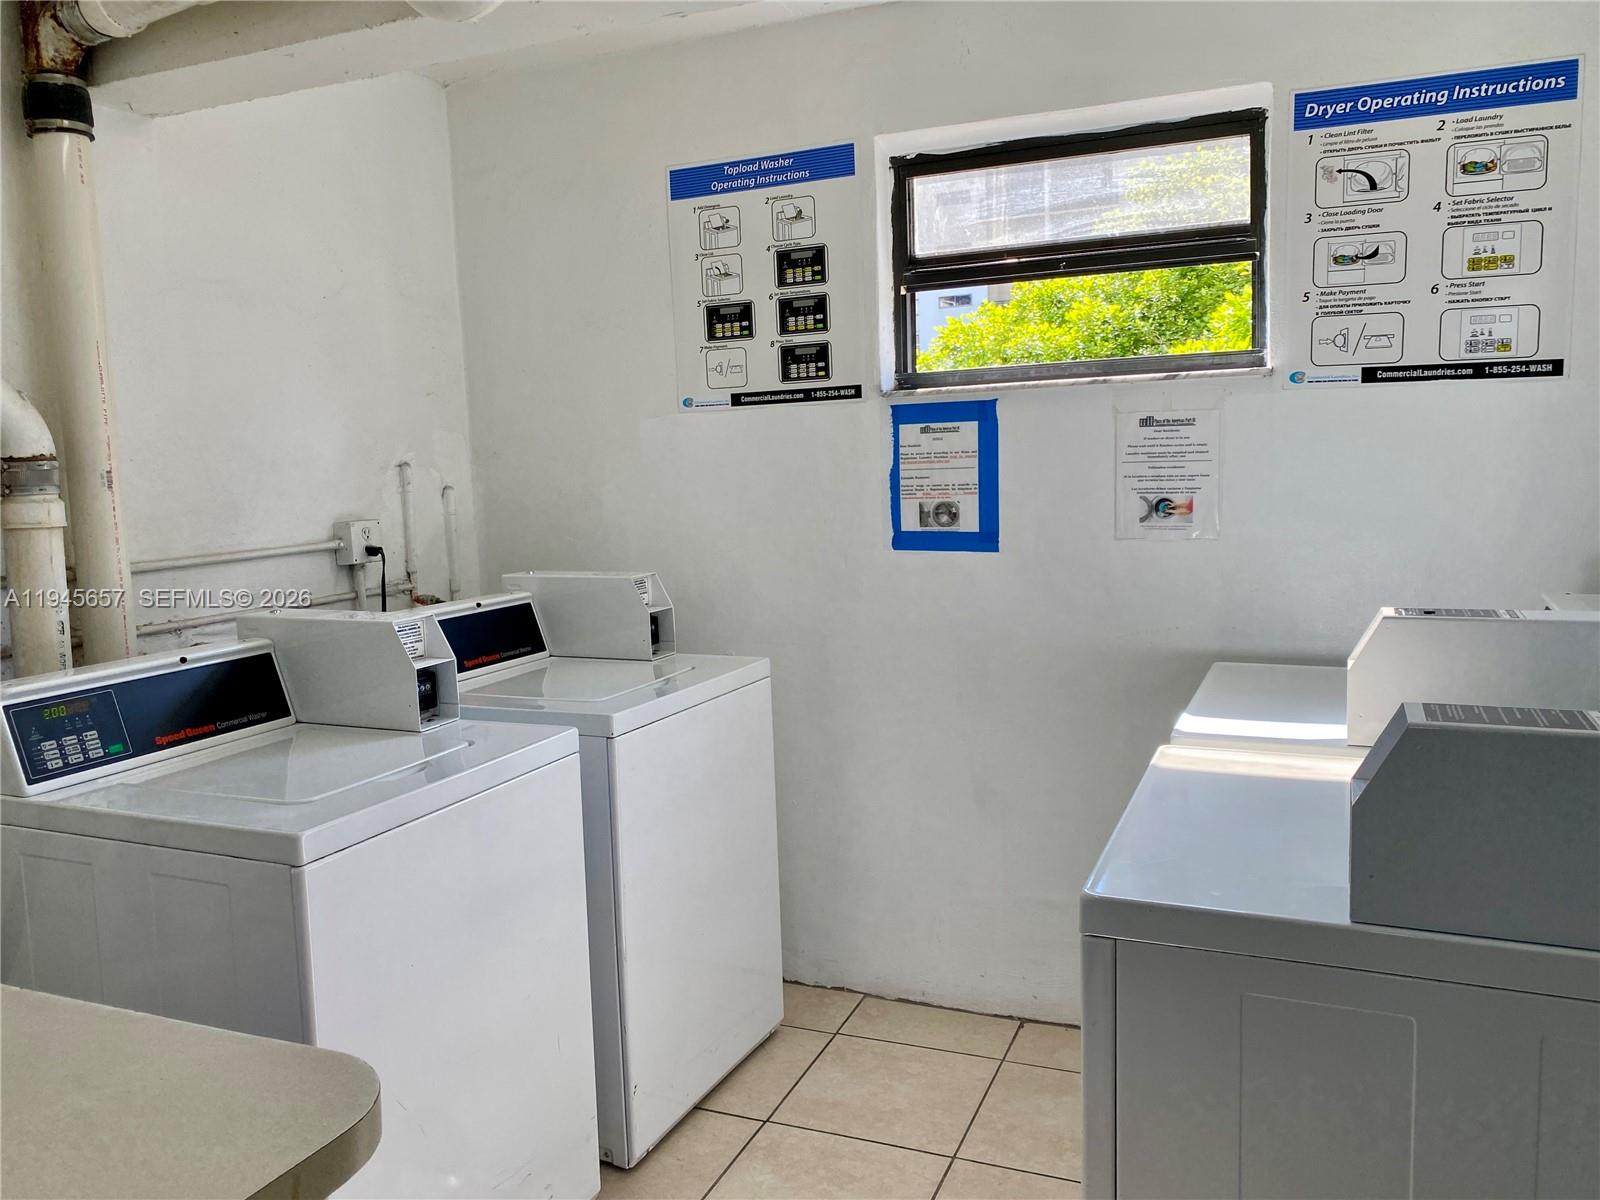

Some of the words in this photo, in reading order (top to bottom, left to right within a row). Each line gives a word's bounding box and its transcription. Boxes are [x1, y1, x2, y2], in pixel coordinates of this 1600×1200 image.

[1304, 102, 1354, 119] Dryer
[1357, 89, 1449, 113] Operating
[1453, 74, 1566, 100] Instructions
[1456, 116, 1474, 124] Load
[1474, 114, 1504, 122] Laundry
[1436, 120, 1446, 132] 2
[1308, 135, 1314, 145] 1
[723, 161, 758, 176] Topload
[760, 158, 794, 170] Washer
[711, 177, 755, 192] Operating
[757, 170, 810, 185] Instructions
[1464, 197, 1484, 205] Fabric
[1433, 201, 1442, 212] 4
[1304, 213, 1312, 223] 3
[1340, 209, 1366, 217] Loading
[766, 245, 771, 253] 4
[1338, 289, 1366, 297] Payment
[1431, 283, 1440, 295] 6
[768, 293, 774, 301] 6
[1302, 292, 1310, 302] 5
[697, 300, 701, 308] 5
[770, 340, 775, 348] 8
[700, 346, 704, 354] 7
[1377, 367, 1473, 378] CommercialLaundries.com
[1485, 363, 1553, 374] 1-855-254-WASH
[741, 392, 804, 403] CommercialLaundries.com
[811, 388, 855, 399] 1-855-254-WASH
[155, 728, 186, 745] Speed
[186, 724, 215, 737] Queen
[216, 716, 248, 730] Commercial
[248, 711, 268, 722] Washer
